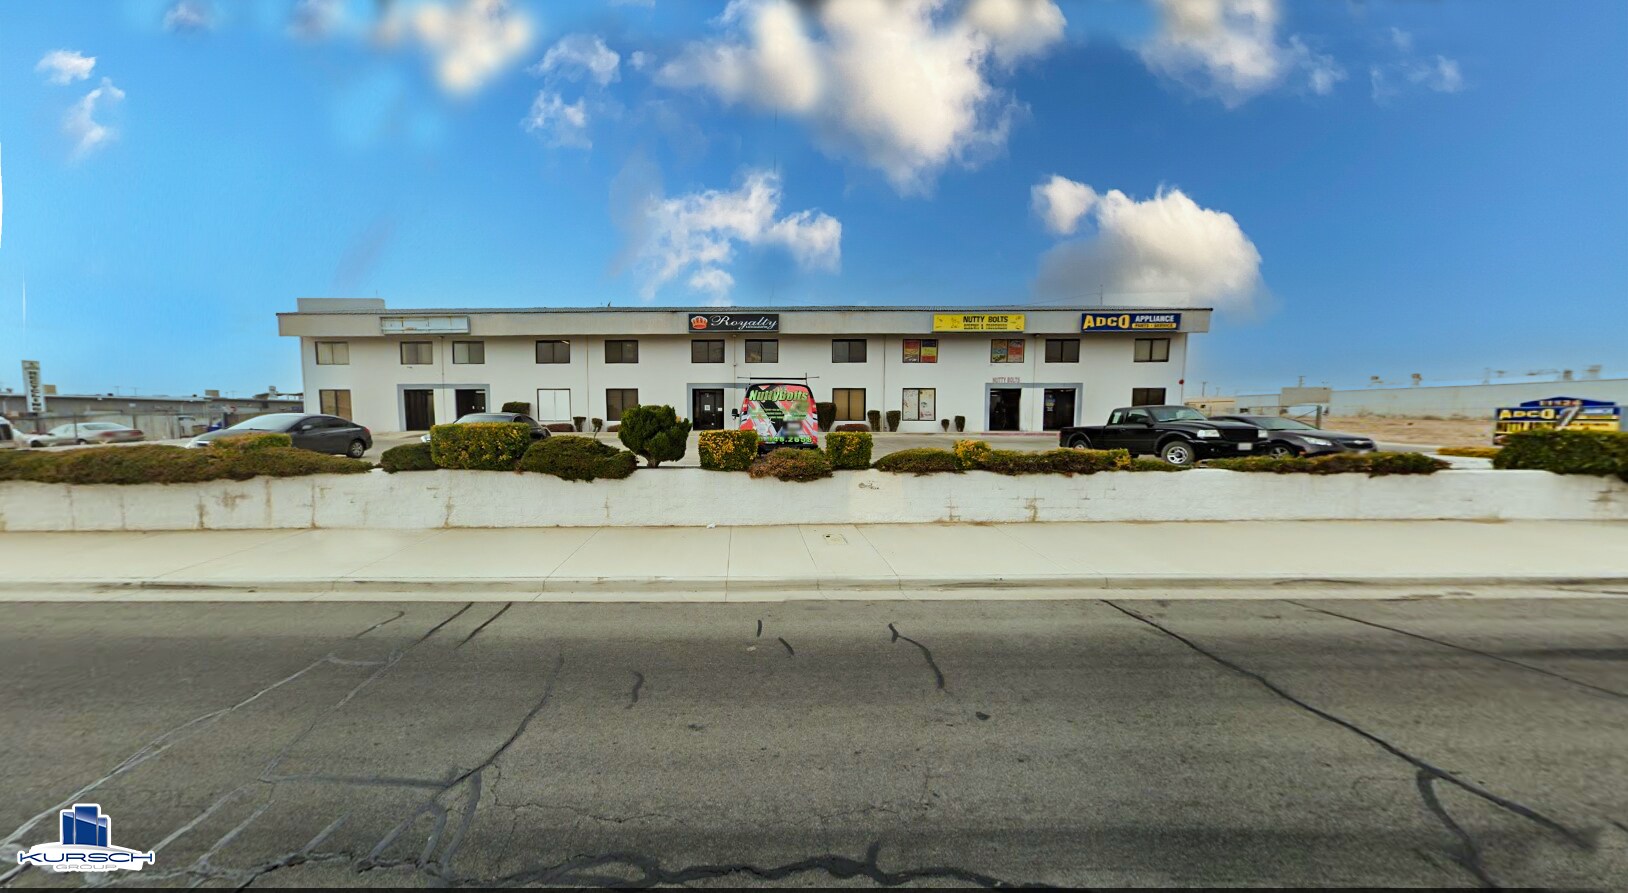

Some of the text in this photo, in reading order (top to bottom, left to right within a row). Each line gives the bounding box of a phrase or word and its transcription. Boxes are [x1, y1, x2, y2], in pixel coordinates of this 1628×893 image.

[709, 315, 777, 330] Royalty
[1082, 314, 1175, 329] ADCO APPLIANCE
